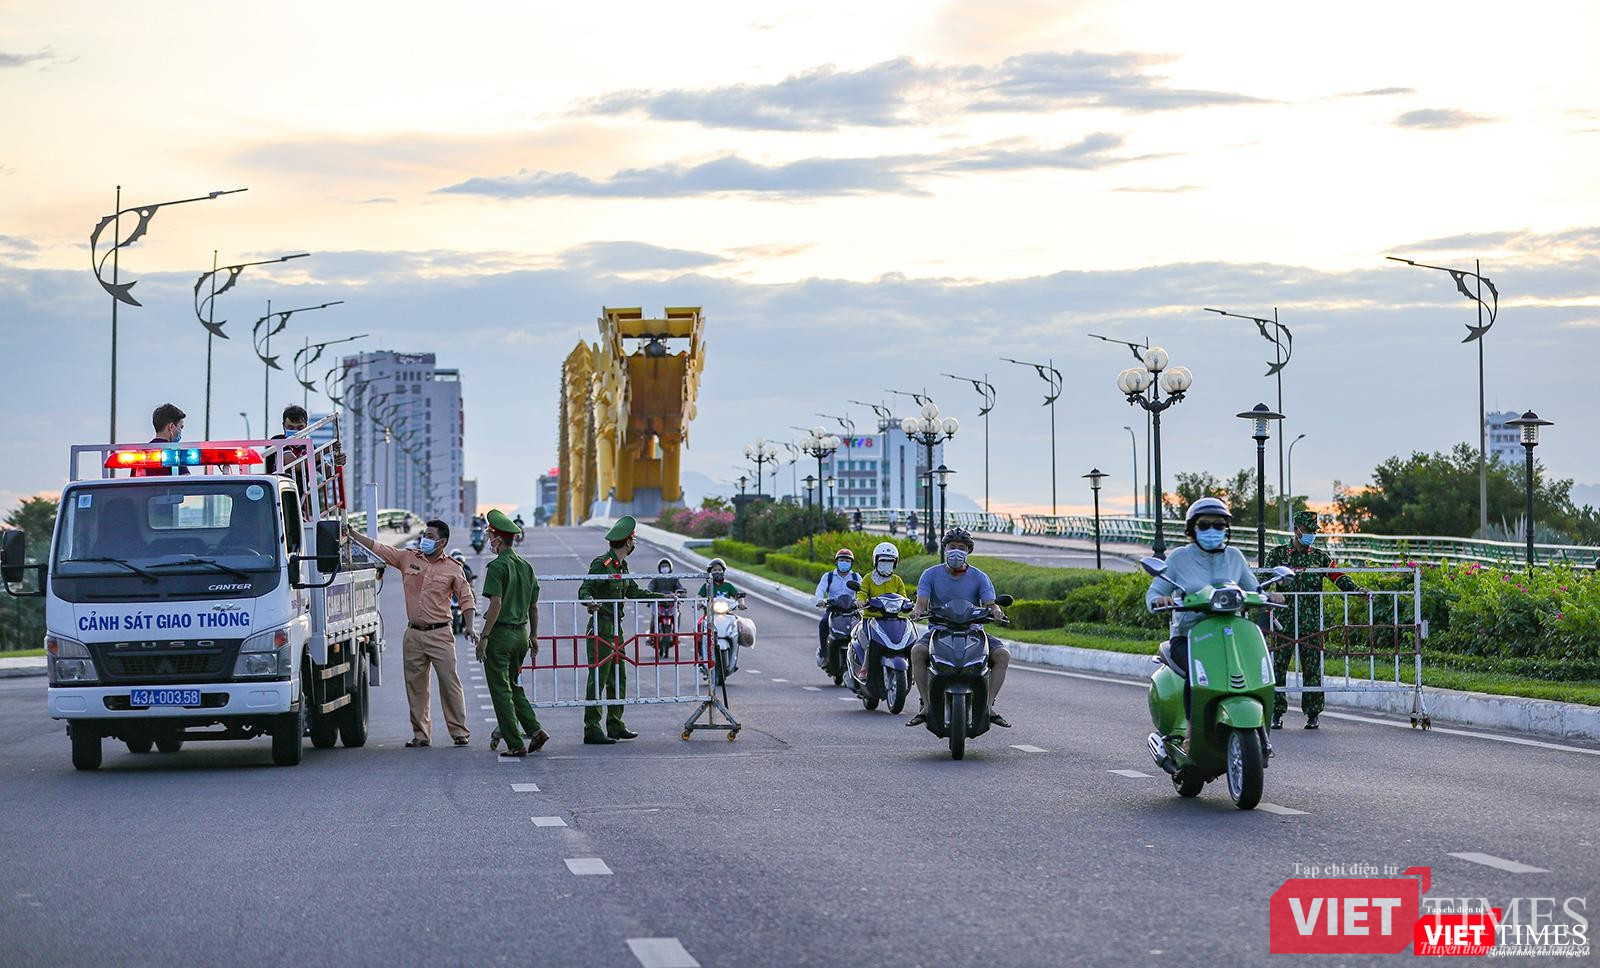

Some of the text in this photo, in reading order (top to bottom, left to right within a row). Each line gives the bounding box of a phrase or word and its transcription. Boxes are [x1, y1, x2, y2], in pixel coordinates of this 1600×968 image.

[208, 583, 252, 591] CANTER
[79, 609, 250, 631] CẢNH SÁT GIAO THÔNG
[115, 640, 215, 649] FUSO
